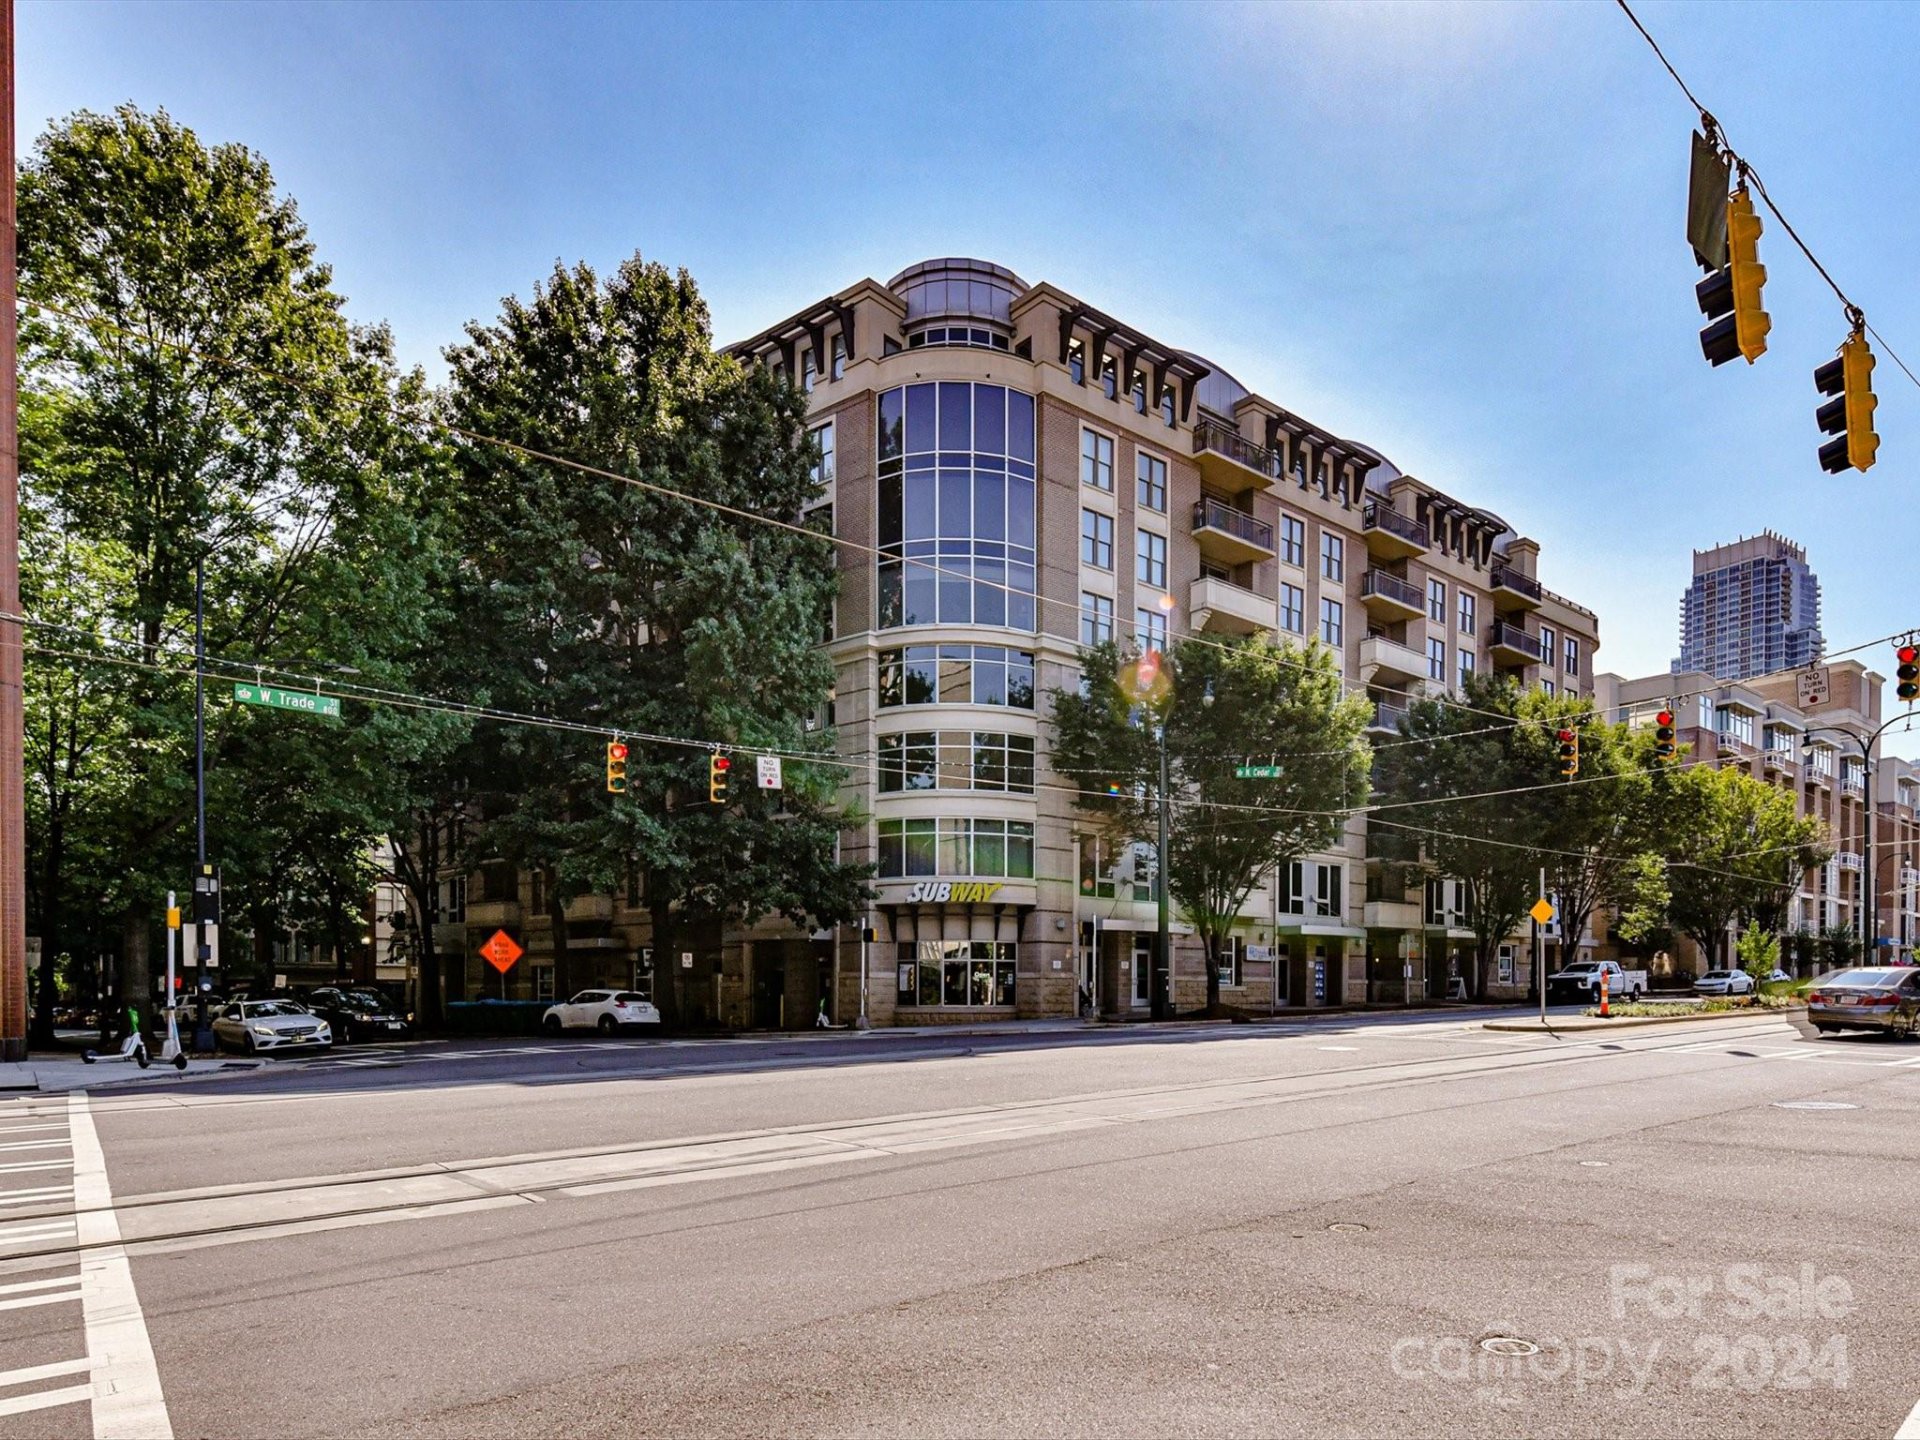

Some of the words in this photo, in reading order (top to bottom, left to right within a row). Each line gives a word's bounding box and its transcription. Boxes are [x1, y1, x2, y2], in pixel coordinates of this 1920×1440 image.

[1805, 672, 1819, 681] NO
[1804, 680, 1823, 689] TURN
[1813, 686, 1827, 694] RED
[279, 692, 315, 709] Trade
[905, 882, 1004, 903] SUBWAY
